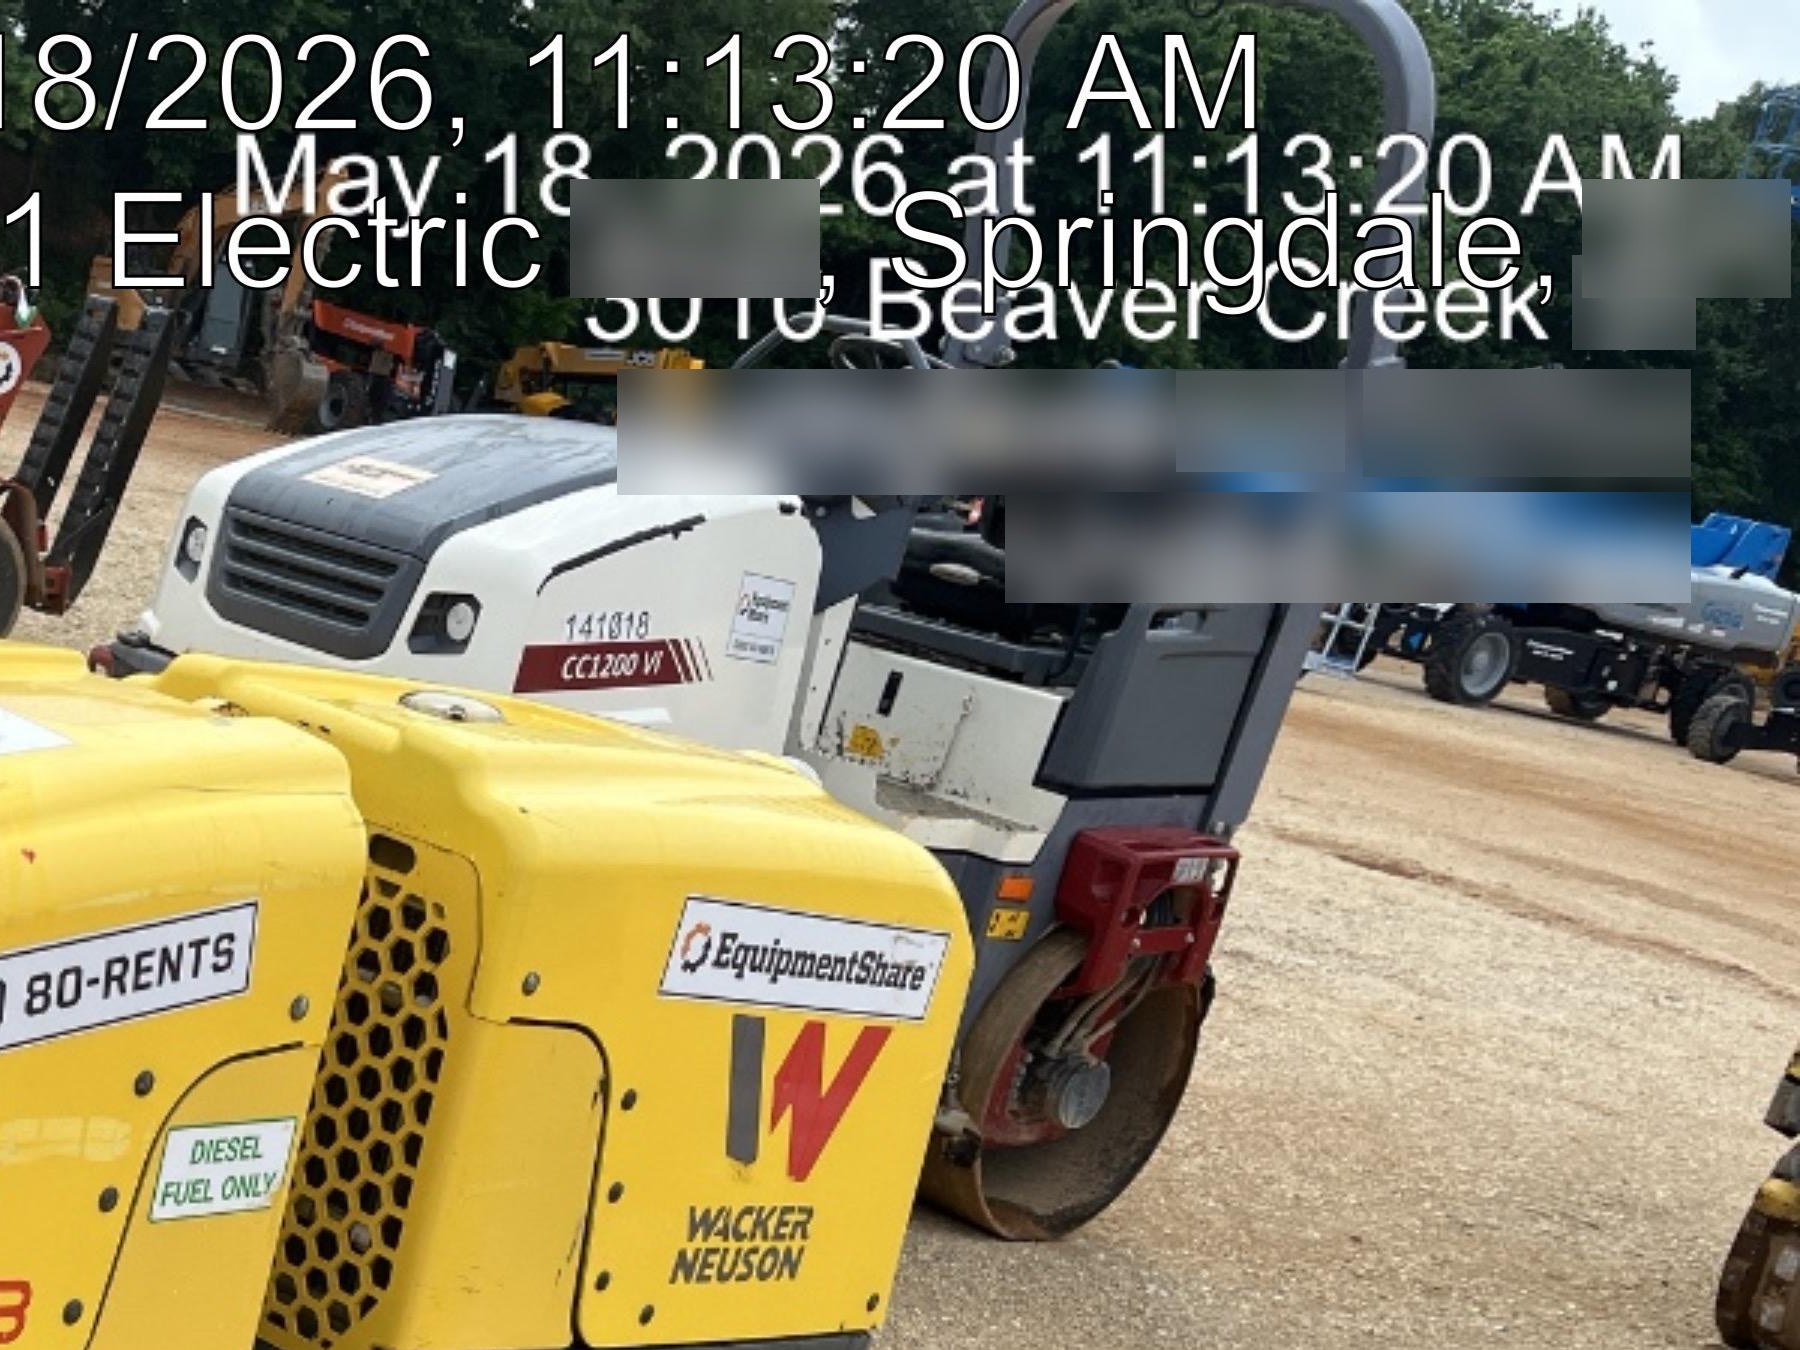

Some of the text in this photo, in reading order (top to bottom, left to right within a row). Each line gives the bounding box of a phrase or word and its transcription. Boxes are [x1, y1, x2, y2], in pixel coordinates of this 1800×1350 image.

[566, 610, 651, 641] 141018
[561, 652, 639, 681] CC1200
[25, 931, 236, 1017] 80-RENTS
[713, 931, 927, 993] EquipmentShare
[189, 1135, 264, 1164] DIESEL
[160, 1172, 279, 1208] FUEL ONLY
[686, 1204, 814, 1243] WACKER
[669, 1245, 805, 1285] NEUSON
